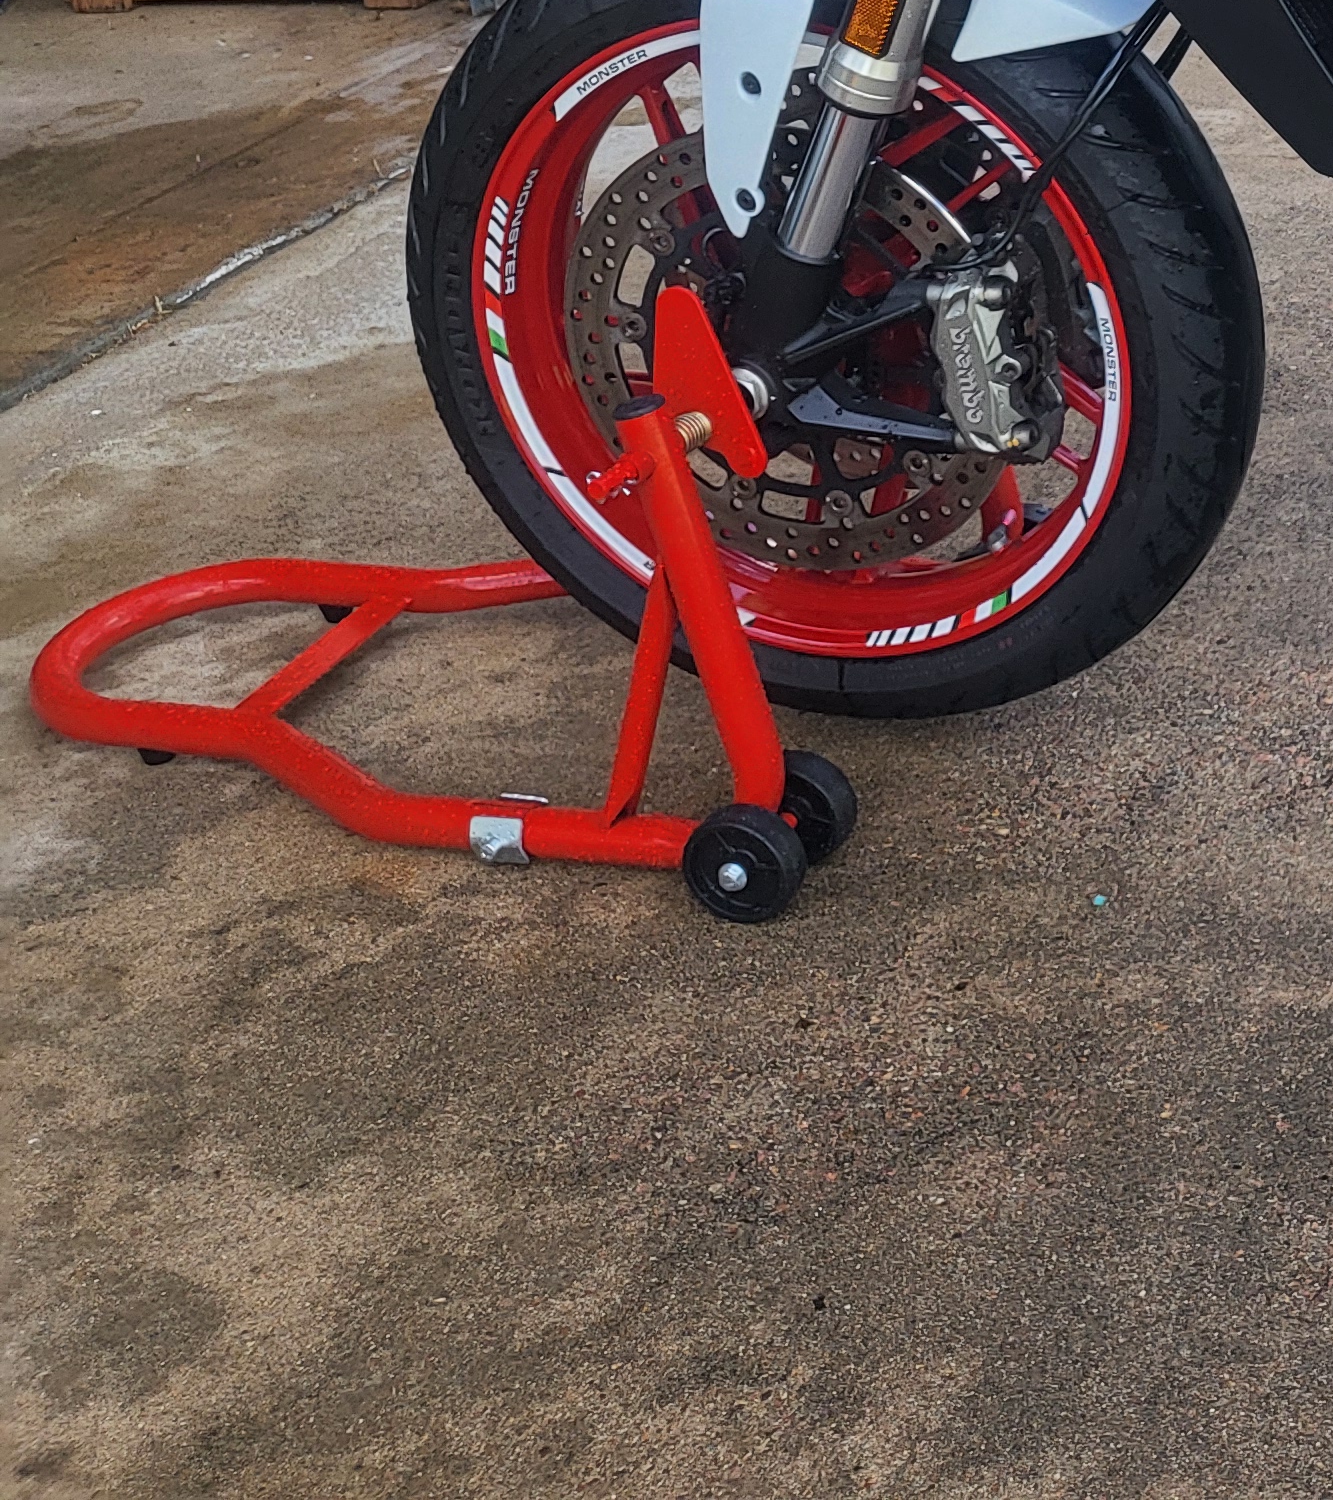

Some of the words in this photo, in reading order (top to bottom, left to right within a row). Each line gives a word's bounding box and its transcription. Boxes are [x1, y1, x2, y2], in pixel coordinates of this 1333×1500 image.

[576, 49, 649, 96] MONSTER
[504, 167, 540, 295] MONSTER
[949, 325, 985, 424] brembo
[1100, 317, 1118, 402] MONSTER
